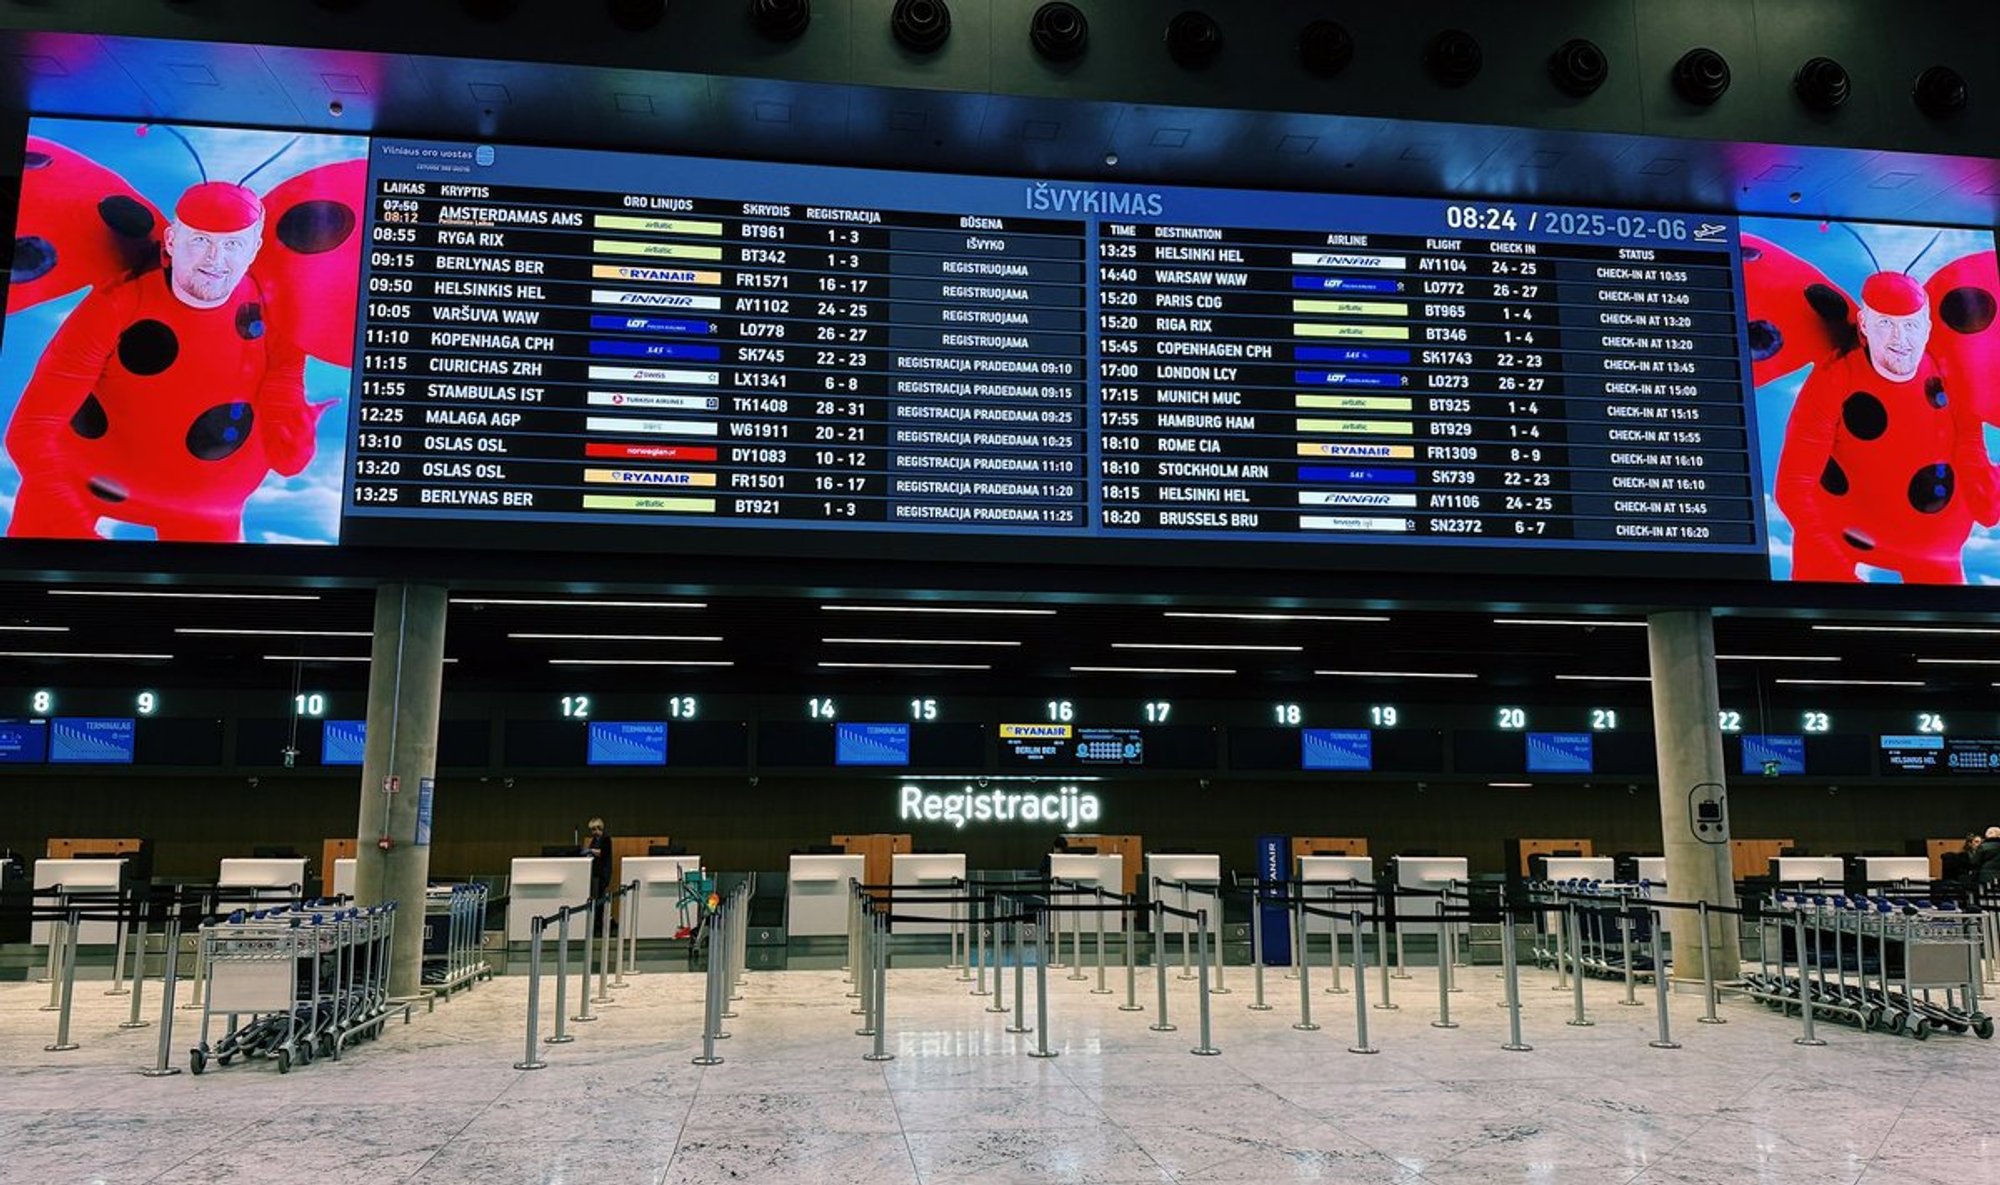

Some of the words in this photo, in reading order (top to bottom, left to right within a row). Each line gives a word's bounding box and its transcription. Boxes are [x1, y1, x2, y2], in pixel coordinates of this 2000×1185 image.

[382, 145, 420, 157] Vilniaus
[383, 182, 426, 194] LAIKAS
[440, 185, 490, 198] KRYPTIS
[624, 196, 647, 207] ORO
[651, 198, 693, 211] LINIJOS
[743, 204, 790, 216] SKRYDIS
[807, 208, 881, 224] REGISTRACIJA
[960, 215, 1004, 230] BŪSENA
[1026, 182, 1163, 216] IŠVYKIMAS
[383, 211, 419, 223] 08:12
[1447, 206, 1517, 231] 08:24
[1545, 212, 1687, 240] 2025-02-06
[439, 206, 547, 224] AMSTERDAMAS
[552, 212, 582, 226] AMS
[742, 224, 784, 238] BT961
[967, 236, 1005, 251] IŠVYKO
[374, 227, 415, 241] 08:55
[438, 231, 475, 244] RYGA
[480, 233, 503, 246] RIX
[742, 249, 785, 263] BT342
[943, 262, 1028, 276] REGISTRUOJAMA
[1110, 225, 1135, 236] TIME
[1155, 227, 1221, 239] DESTINATION
[1327, 235, 1367, 246] AIRLINE
[1427, 239, 1461, 250] FLIGHT
[1490, 242, 1522, 253] CHECK
[1525, 244, 1535, 254] IN
[1619, 249, 1654, 260] STATUS
[1100, 244, 1136, 257] 13:25
[1156, 247, 1214, 261] HELSINKI
[1219, 249, 1244, 262] HEL
[1317, 255, 1382, 266] FINNAIR
[1419, 258, 1466, 271] AY1104
[372, 253, 414, 267] 09:15
[437, 256, 510, 272] BERLYNAS
[515, 260, 544, 274] BER
[630, 269, 696, 282] RYANAIR
[737, 273, 787, 288] FR1571
[943, 286, 1028, 300] REGISTRUOJAMA
[1101, 268, 1137, 281] 14:40
[1155, 270, 1212, 284] WARSAW
[1215, 273, 1247, 285] WAW
[370, 278, 412, 292] 09:50
[435, 282, 512, 297] HELSINKIS
[517, 286, 545, 299] HEL
[620, 293, 693, 306] FINNAIR
[736, 298, 788, 313] AY1102
[1100, 292, 1137, 305] 15:20
[1157, 294, 1193, 307] PARIS
[1197, 295, 1222, 308] CDG
[1425, 305, 1465, 317] BT965
[369, 304, 410, 318] 10:05
[433, 305, 498, 322] VARŠUVA
[502, 310, 539, 324] WAW
[1101, 316, 1137, 329] 15:20
[1157, 318, 1187, 331] RIGA
[1191, 319, 1212, 332] RIX
[1427, 328, 1467, 341] BT346
[367, 330, 409, 344] 11:10
[432, 332, 520, 349] KOPENHAGA
[525, 337, 553, 350] CPH
[739, 348, 784, 362] SK745
[1101, 340, 1137, 353] 15:45
[1157, 342, 1242, 356] COPENHAGEN
[1247, 345, 1271, 358] CPH
[1423, 351, 1472, 364] SK1743
[365, 356, 406, 369] 11:15
[430, 358, 508, 374] CIURICHAS
[512, 362, 542, 376] ZRH
[735, 373, 785, 387] LX1341
[1101, 364, 1137, 377] 17:00
[1157, 366, 1209, 379] LONDON
[1214, 368, 1237, 380] LCY
[363, 382, 405, 395] 11:55
[428, 384, 516, 400] STAMBULAS
[521, 388, 544, 401] IST
[733, 398, 787, 412] TK1408
[1101, 388, 1138, 401] 17:15
[1158, 390, 1209, 403] MUNICH
[1213, 392, 1241, 404] MUC
[1430, 399, 1470, 411] BT925
[362, 408, 403, 422] 12:25
[426, 410, 487, 425] MALAGA
[491, 413, 521, 426] AGP
[731, 423, 787, 437] W61911
[1102, 412, 1138, 425] 17:55
[1158, 414, 1222, 428] HAMBURG
[1226, 416, 1254, 429] HAM
[1431, 422, 1471, 435] BT929
[359, 434, 401, 448] 13:10
[425, 436, 473, 451] OSLAS
[478, 438, 507, 452] OSL
[732, 449, 786, 462] DY1083
[1102, 437, 1139, 450] 18:10
[1159, 439, 1195, 451] ROME
[1200, 439, 1220, 452] CIA
[1331, 446, 1391, 456] RYANAIR
[1428, 446, 1477, 459] FR1309
[357, 461, 399, 474] 13:20
[423, 463, 471, 477] OSLAS
[476, 465, 505, 478] OSL
[623, 472, 690, 483] RYANAIR
[732, 474, 784, 488] FR1501
[1102, 461, 1139, 474] 18:10
[1159, 463, 1238, 477] STOCKHOLM
[1242, 465, 1268, 478] ARN
[1432, 470, 1475, 484] SK739
[356, 487, 397, 501] 13:25
[421, 489, 498, 504] BERLYNAS
[503, 492, 532, 506] BER
[736, 500, 779, 513] BT921
[1103, 486, 1139, 499] 18:15
[1159, 487, 1220, 501] HELSINKI
[1224, 489, 1250, 502] HEL
[1325, 494, 1391, 504] FINNAIR
[1430, 495, 1479, 508] AY1106
[1103, 510, 1140, 524] 18:20
[1160, 512, 1227, 526] BRUSSELS
[1232, 514, 1258, 526] BRU
[1431, 519, 1482, 532] SN2372
[34, 692, 49, 712] 8
[139, 693, 153, 713] 9
[296, 695, 322, 714] 10
[562, 697, 587, 716] 12
[671, 698, 695, 717] 13
[810, 699, 834, 717] 14
[912, 700, 936, 719] 15
[1049, 702, 1072, 721] 16
[1147, 703, 1169, 721] 17
[1276, 705, 1300, 724] 18
[1372, 707, 1396, 725] 19
[1500, 709, 1524, 727] 20
[1594, 710, 1614, 728] 21
[1719, 712, 1739, 730] 22
[1805, 713, 1828, 731] 23
[1920, 714, 1944, 732] 24
[1014, 727, 1066, 736] RYANAIR
[902, 784, 1099, 828] Registracija
